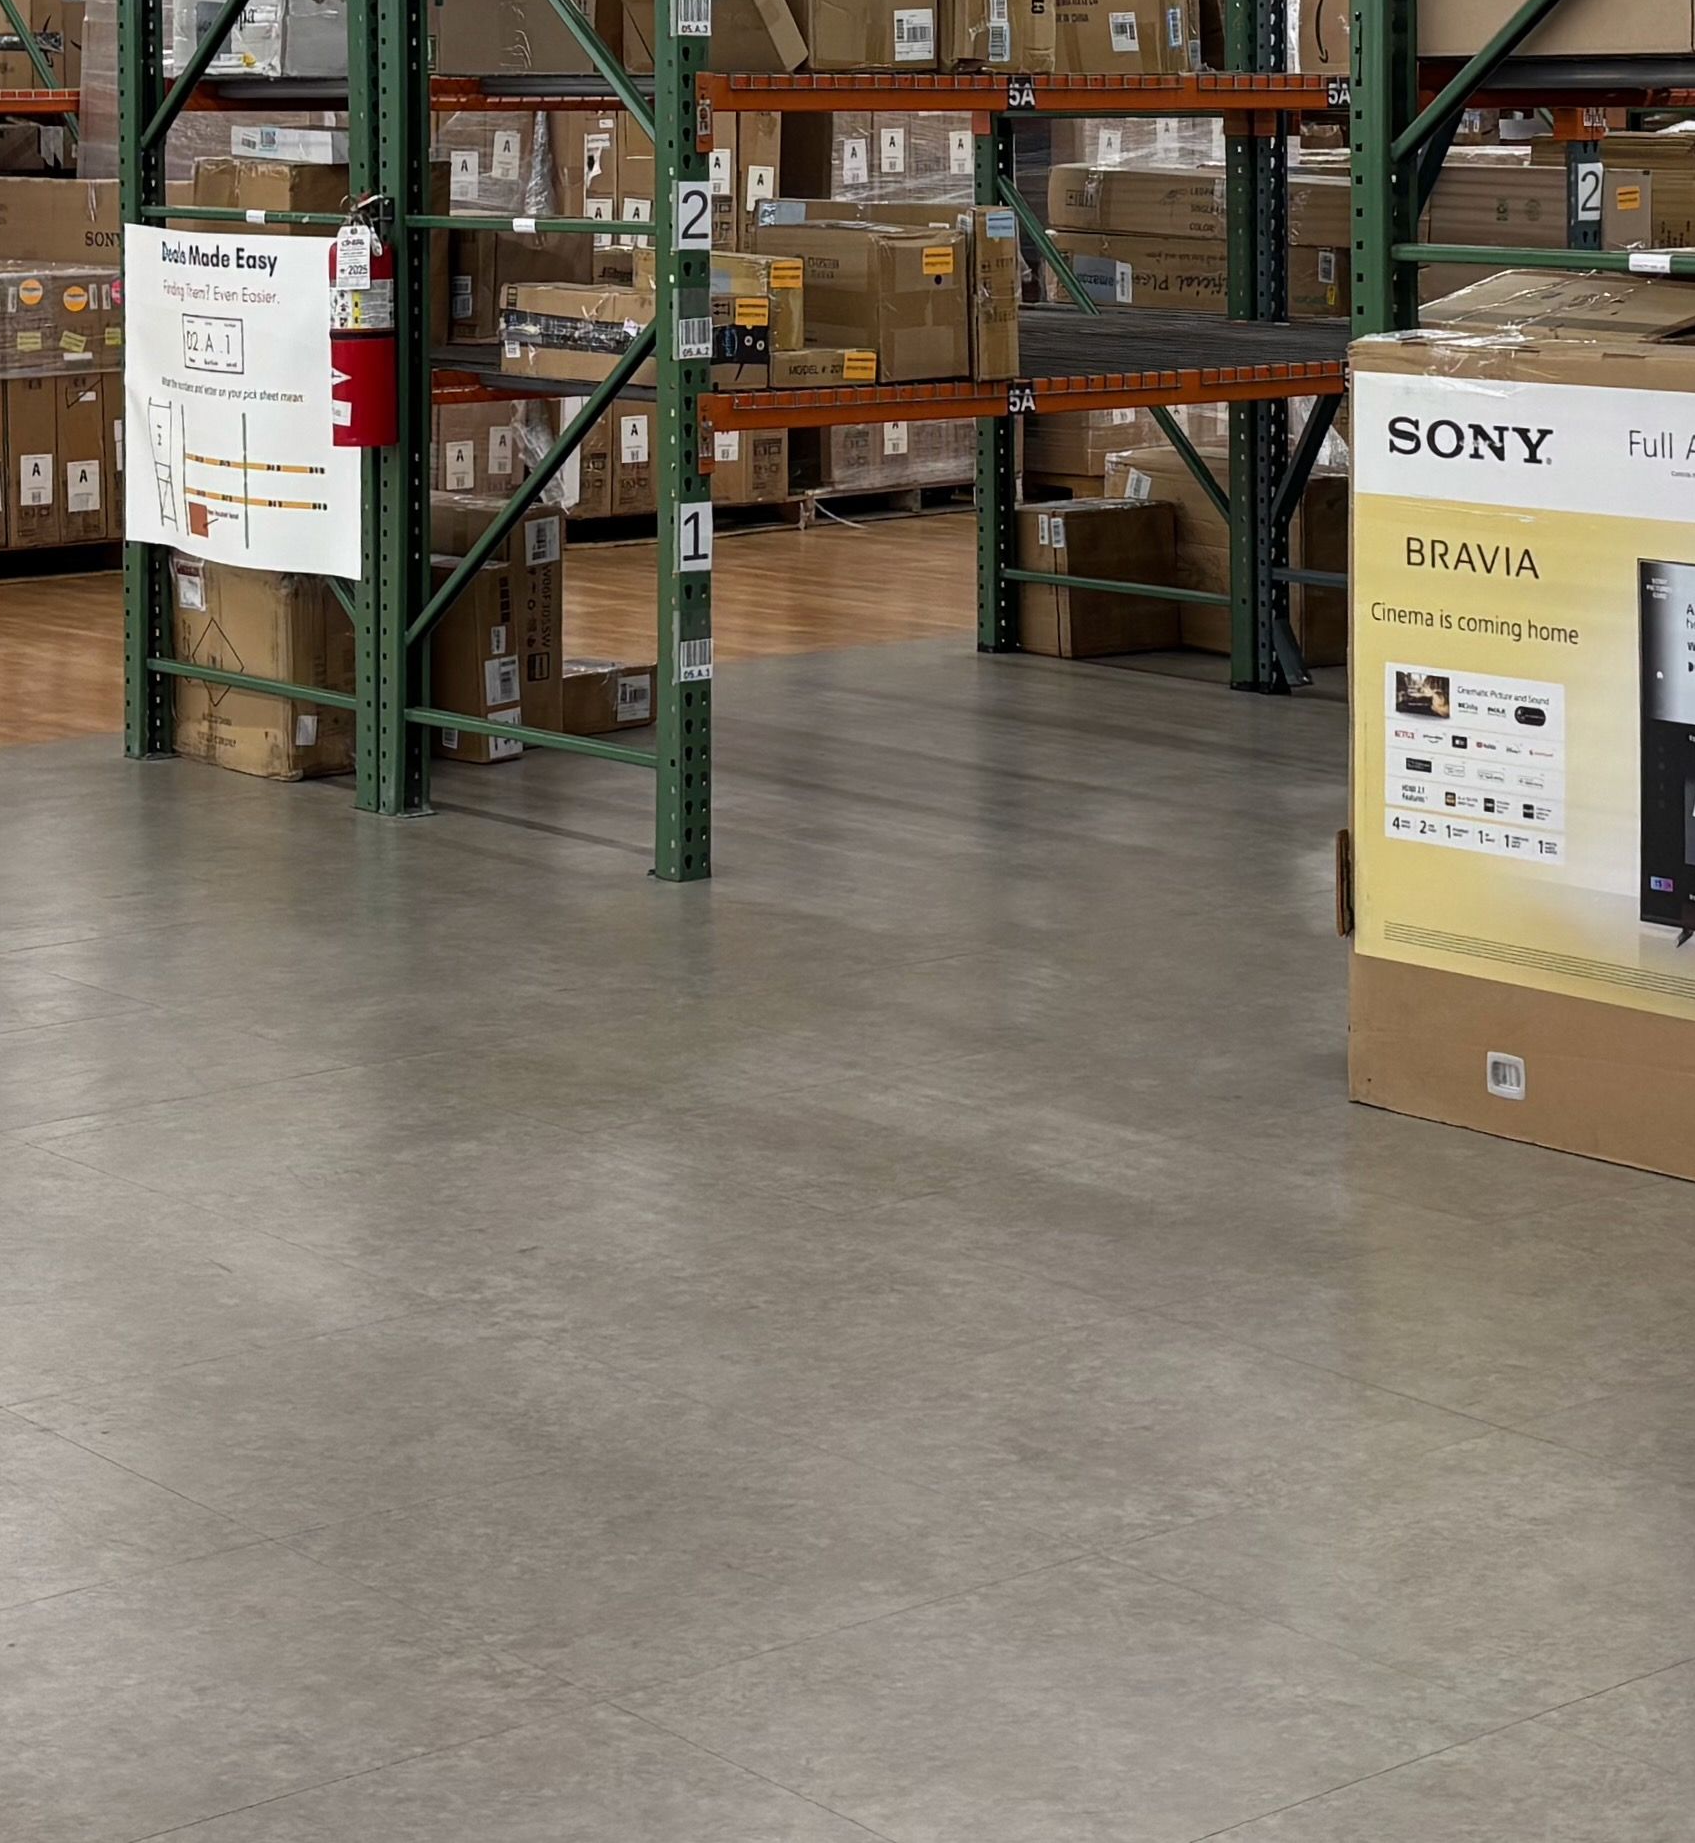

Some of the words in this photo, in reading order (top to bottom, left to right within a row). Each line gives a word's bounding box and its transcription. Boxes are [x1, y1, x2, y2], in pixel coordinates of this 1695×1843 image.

[1010, 85, 1036, 106] 5A
[1327, 84, 1351, 105] 5A
[1163, 122, 1171, 134] A
[503, 139, 511, 153] A
[889, 135, 897, 148] A
[957, 138, 965, 150] A
[1105, 136, 1113, 150] A
[849, 145, 858, 159] A
[460, 158, 469, 173] A
[713, 156, 721, 169] A
[756, 173, 765, 187] A
[1579, 169, 1602, 212] 2
[594, 206, 603, 220] A
[631, 206, 641, 220] A
[681, 190, 709, 240] 2
[162, 241, 186, 265] Deals
[189, 245, 230, 269] Made
[235, 247, 278, 277] Easy
[348, 265, 368, 275] 2025
[213, 285, 238, 302] Even
[242, 287, 281, 305] Easier.
[789, 362, 818, 375] MODEL
[228, 389, 242, 402] your
[243, 390, 257, 402] pick
[260, 391, 279, 402] sheet
[1010, 390, 1036, 414] 5A
[629, 423, 639, 437] A
[498, 434, 508, 446] A
[1388, 416, 1554, 465] SONY
[1629, 430, 1674, 460] Full
[455, 448, 465, 462] A
[31, 461, 42, 477] A
[78, 467, 89, 483] A
[683, 511, 709, 561] 1
[1406, 536, 1540, 580] BRAVIA
[1686, 604, 1695, 617] A
[1370, 602, 1435, 628] Cinema
[1439, 609, 1453, 630] is
[1457, 615, 1523, 643] coming
[1527, 619, 1580, 645] home
[1515, 694, 1528, 703] and
